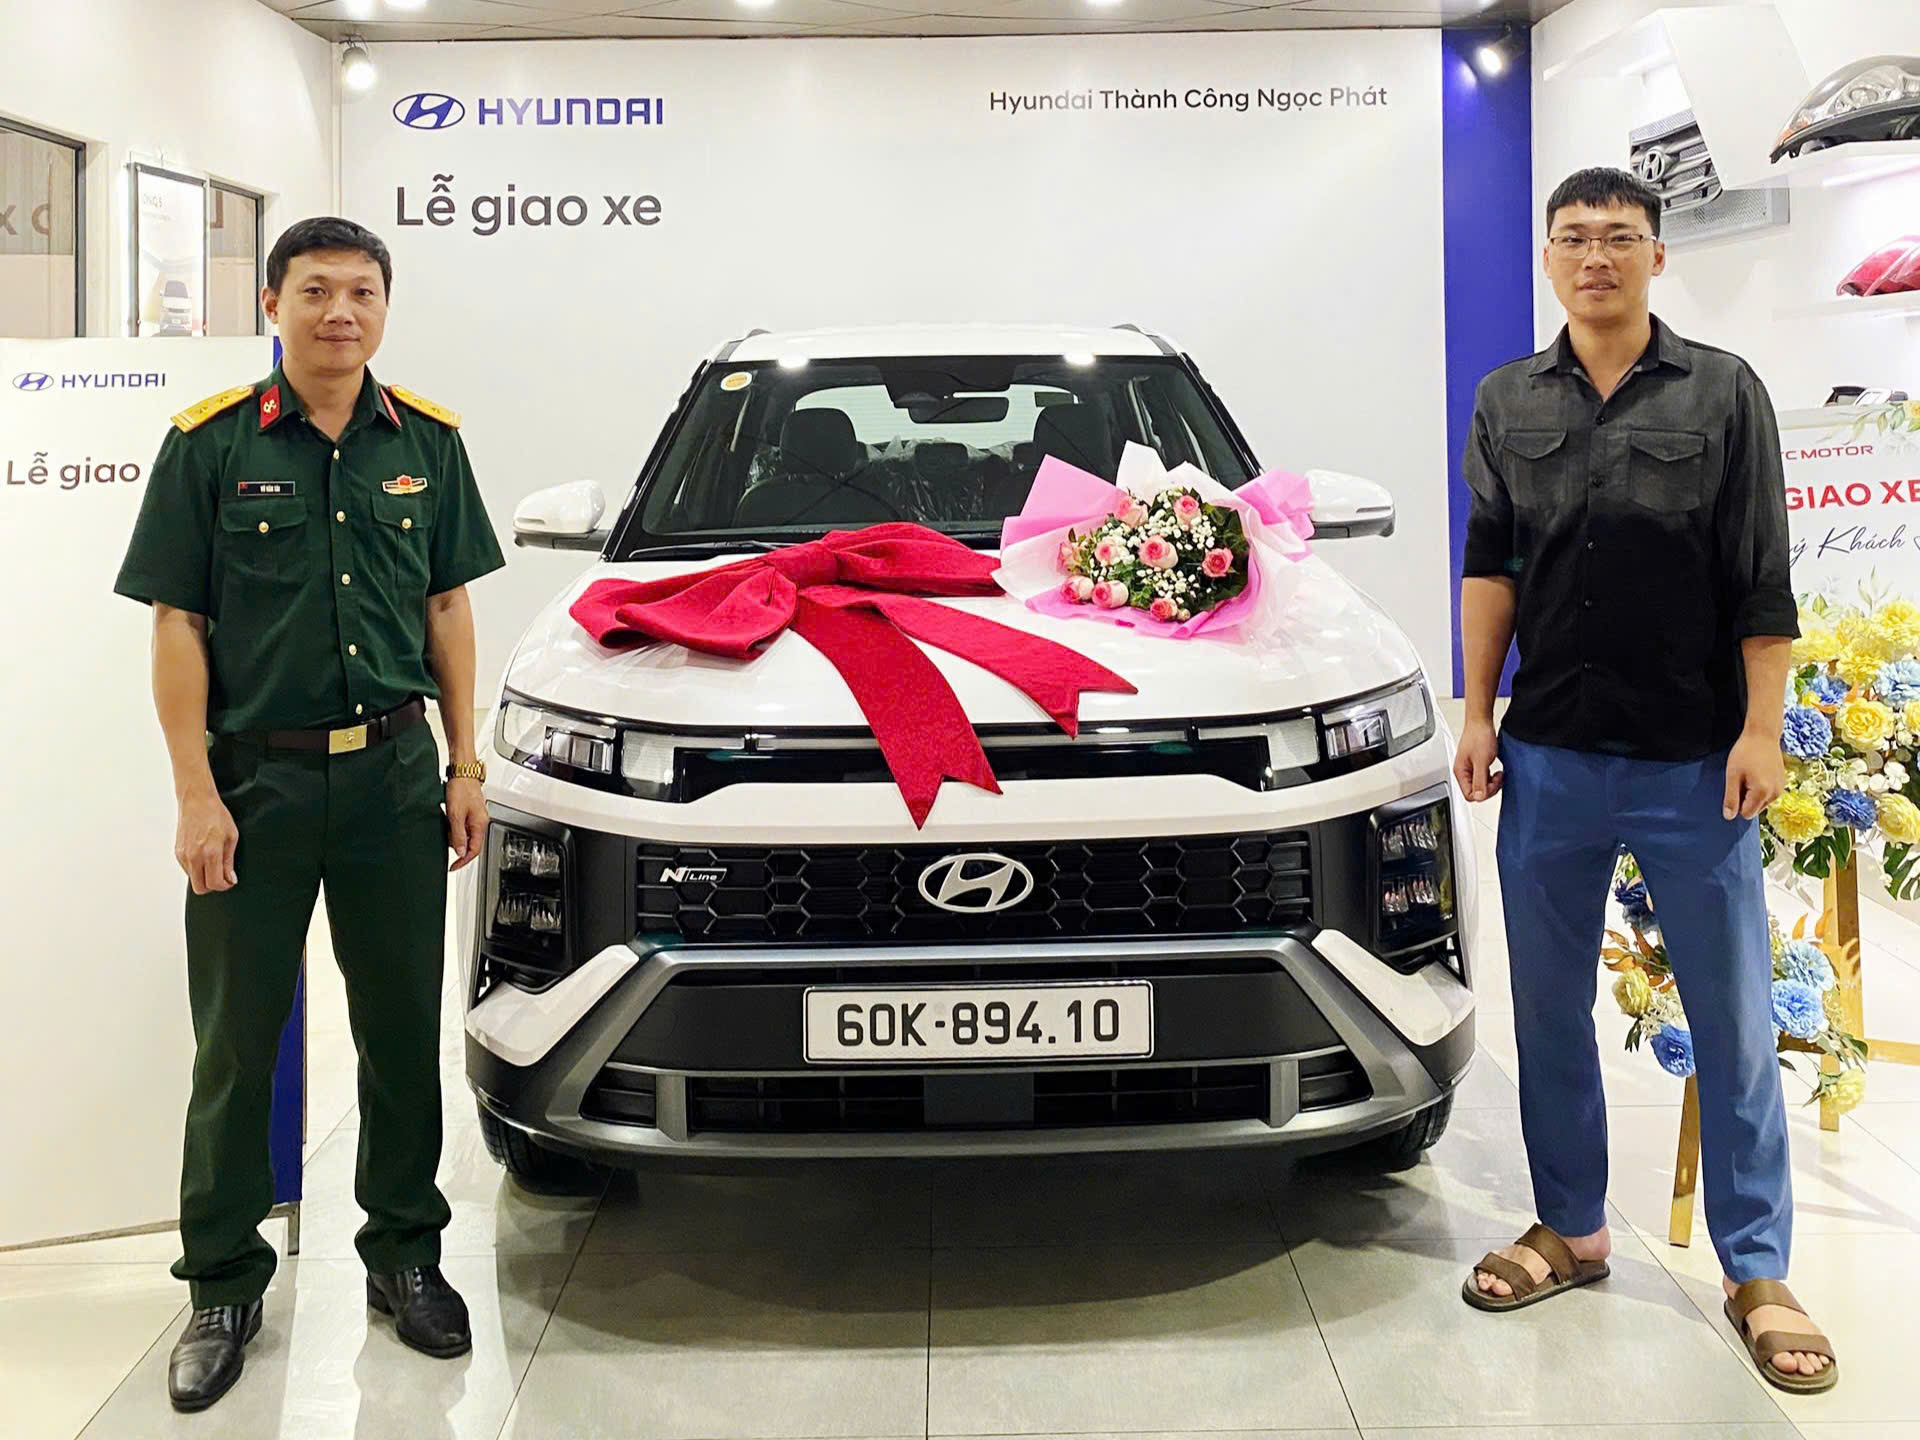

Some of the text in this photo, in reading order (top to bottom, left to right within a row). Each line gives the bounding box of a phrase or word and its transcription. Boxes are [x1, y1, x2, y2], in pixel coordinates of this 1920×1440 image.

[478, 97, 664, 126] HYUNDAI
[989, 84, 1388, 115] Hyundai Thành Công Ngọc Phát
[396, 173, 663, 237] Lễ giao xe
[61, 373, 166, 388] HYUNDAI
[1801, 445, 1874, 460] MOTOR
[6, 451, 141, 490] Lễ giao
[1785, 482, 1872, 511] GIAO
[1817, 523, 1905, 559] Khách
[836, 998, 1120, 1047] 60K-894.10
